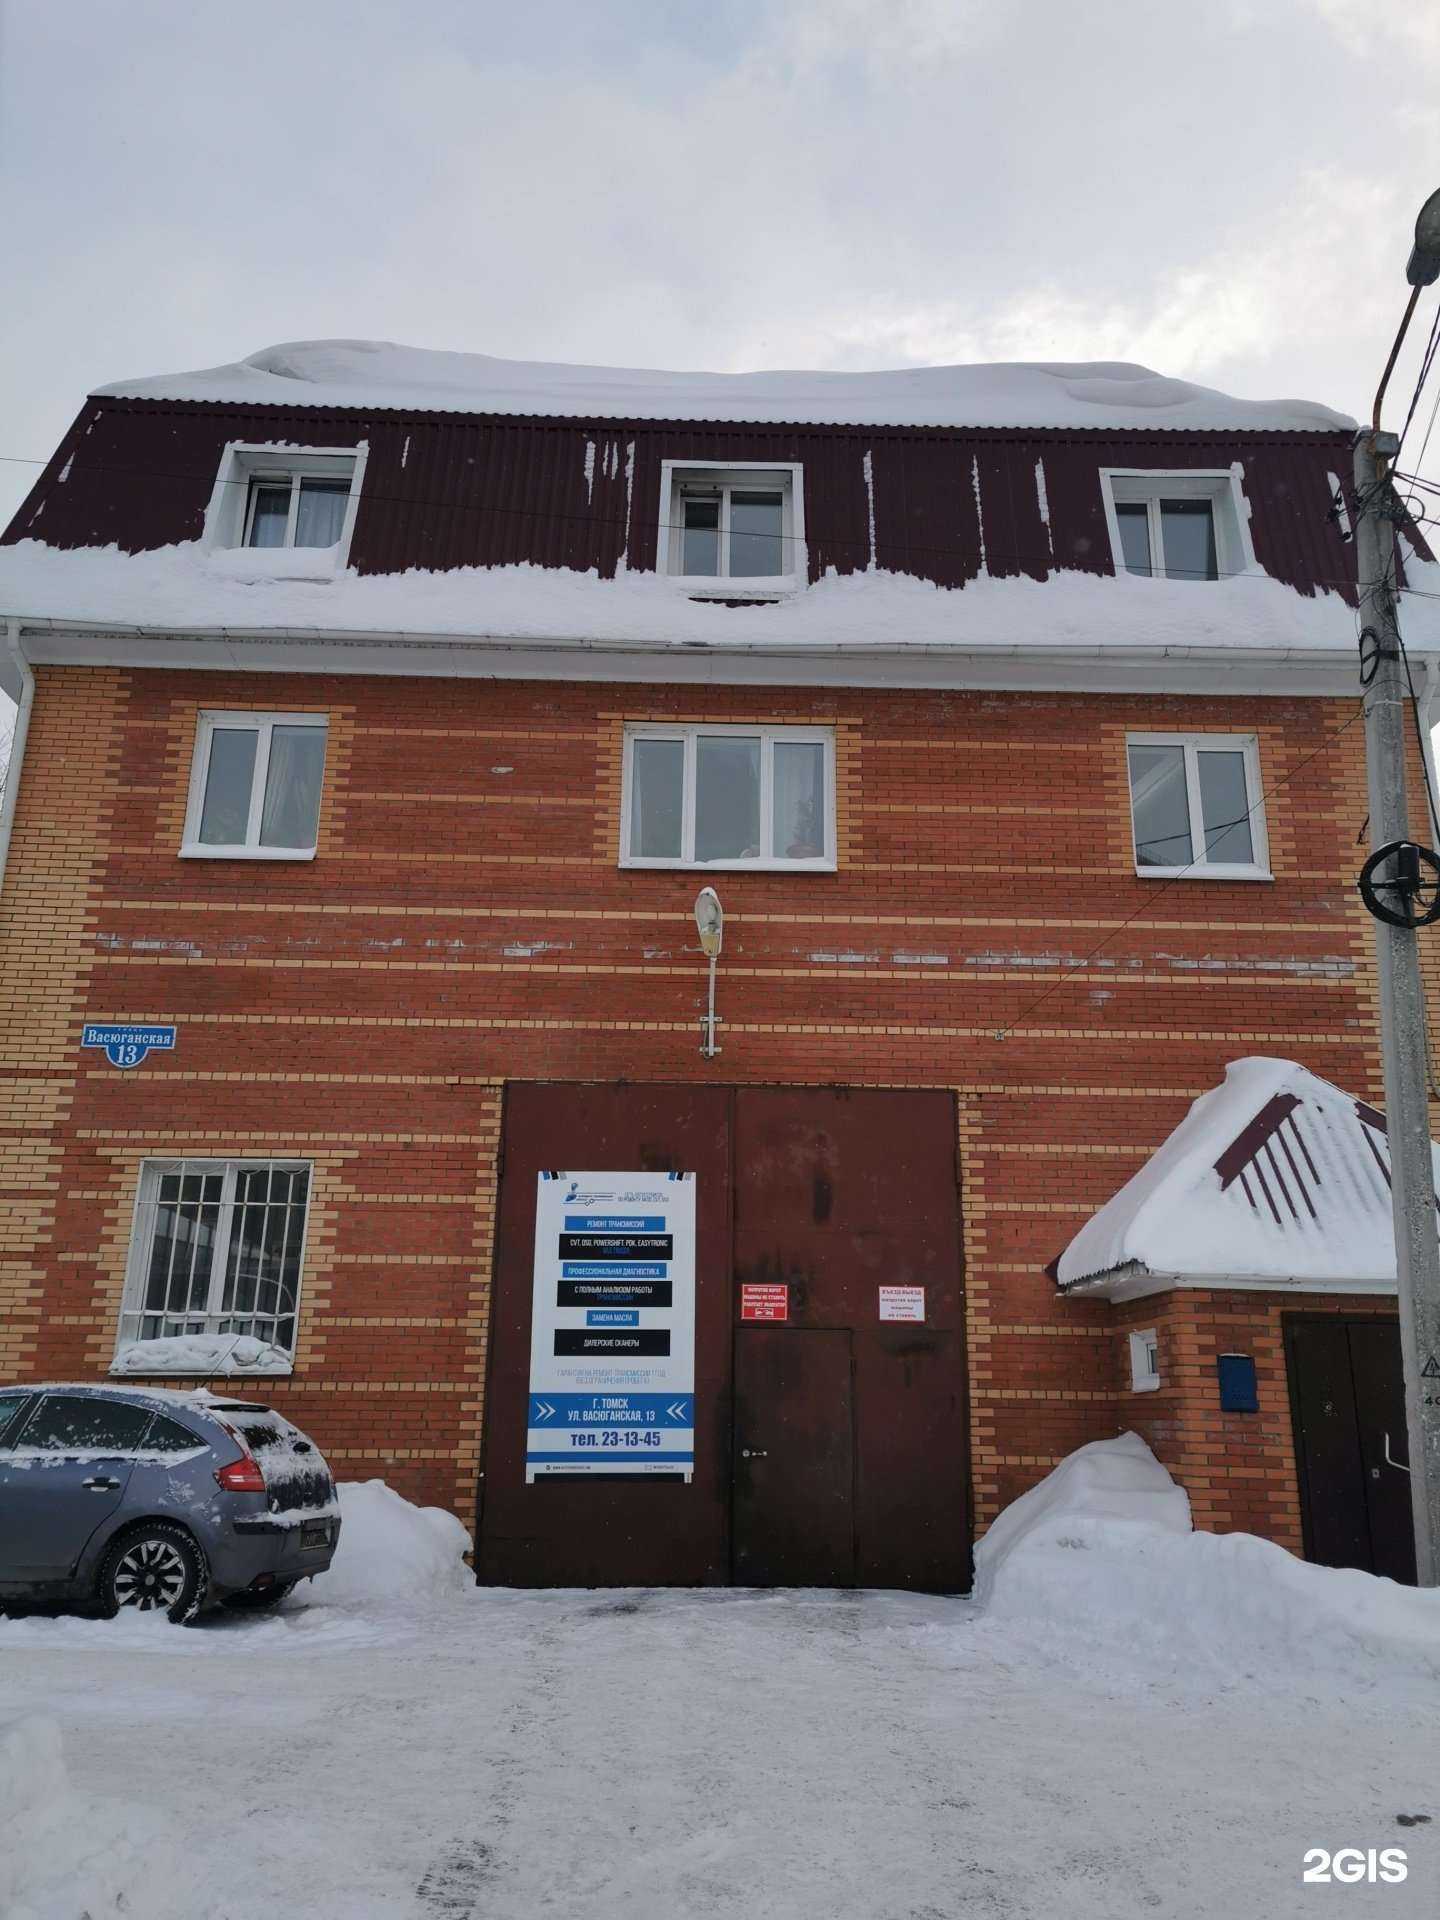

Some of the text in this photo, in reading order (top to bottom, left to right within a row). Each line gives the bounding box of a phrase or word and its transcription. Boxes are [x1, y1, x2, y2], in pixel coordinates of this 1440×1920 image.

[87, 1029, 171, 1045] Васюганская
[117, 1045, 137, 1064] 13
[631, 1286, 653, 1294] РАБОТЫ
[591, 1313, 614, 1322] ЗАМЕНА
[583, 1339, 640, 1347] ДИЛЕРСКИЕ СКАНЕРЫ
[593, 1398, 628, 1408] Г. ТОМСК
[568, 1410, 656, 1422] УЛ. ВАСЮГАНСКАЯ, 13
[571, 1431, 661, 1446] тел. 23-13-45
